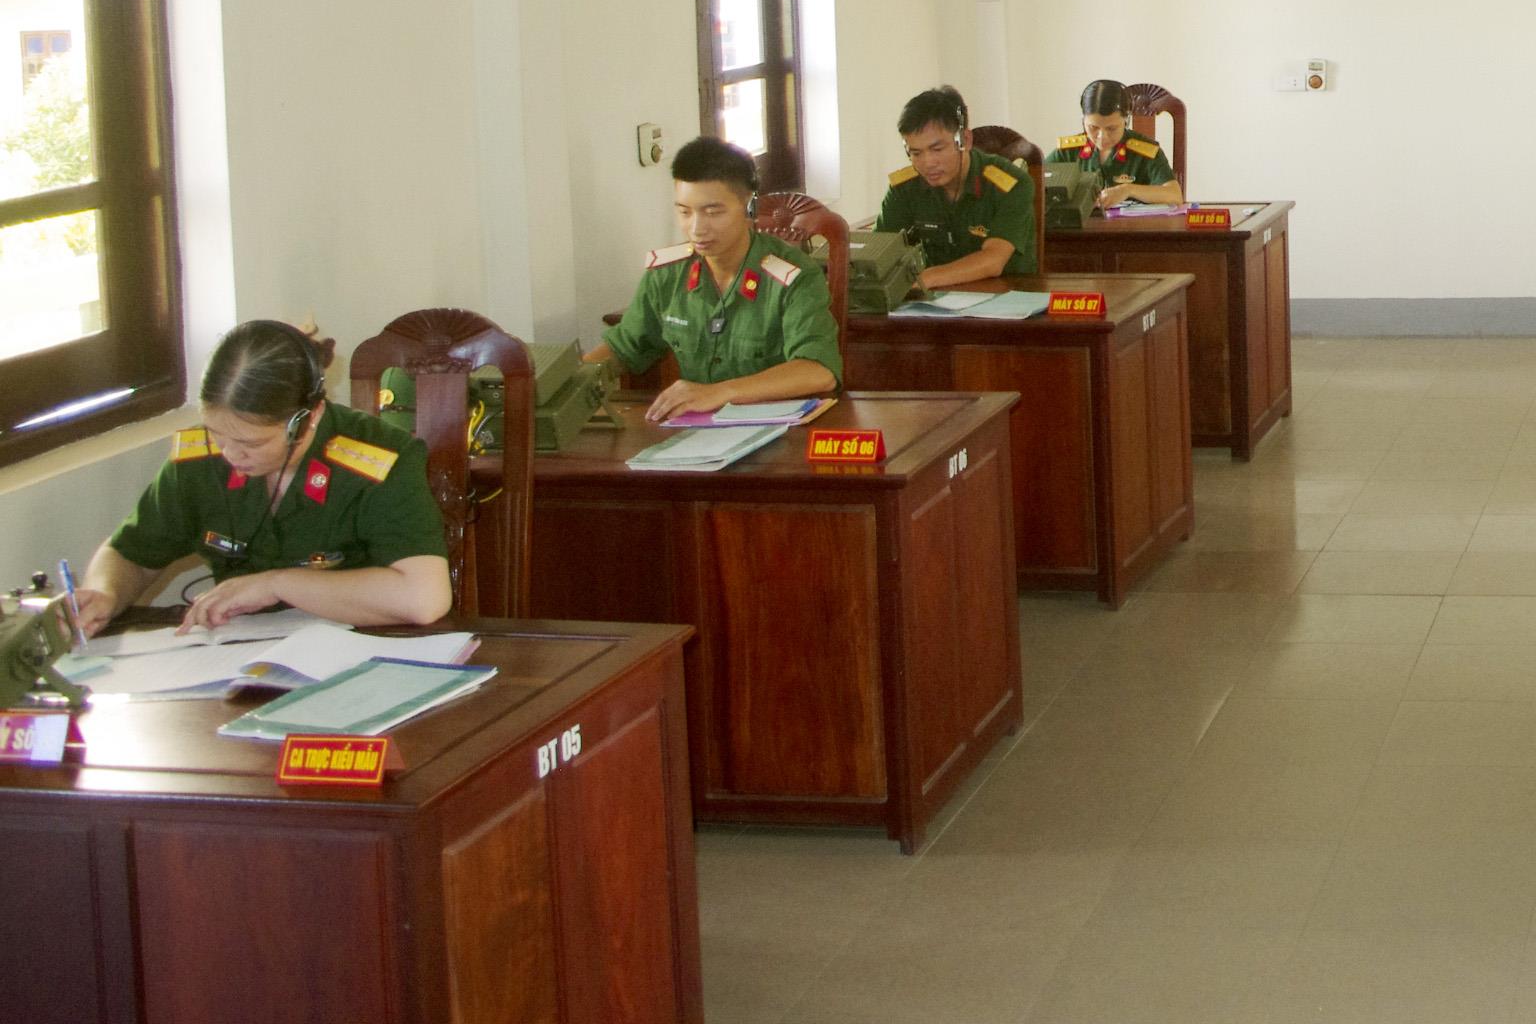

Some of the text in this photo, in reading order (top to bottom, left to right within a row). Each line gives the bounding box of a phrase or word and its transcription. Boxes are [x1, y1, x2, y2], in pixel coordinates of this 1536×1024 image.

[1053, 296, 1098, 310] MÁY SỐ 07
[814, 436, 874, 455] MÁY SỐ 06
[289, 748, 304, 768] CA
[305, 747, 331, 773] TRỰC
[330, 742, 355, 770] KIỂU
[537, 723, 582, 779] BT 05
